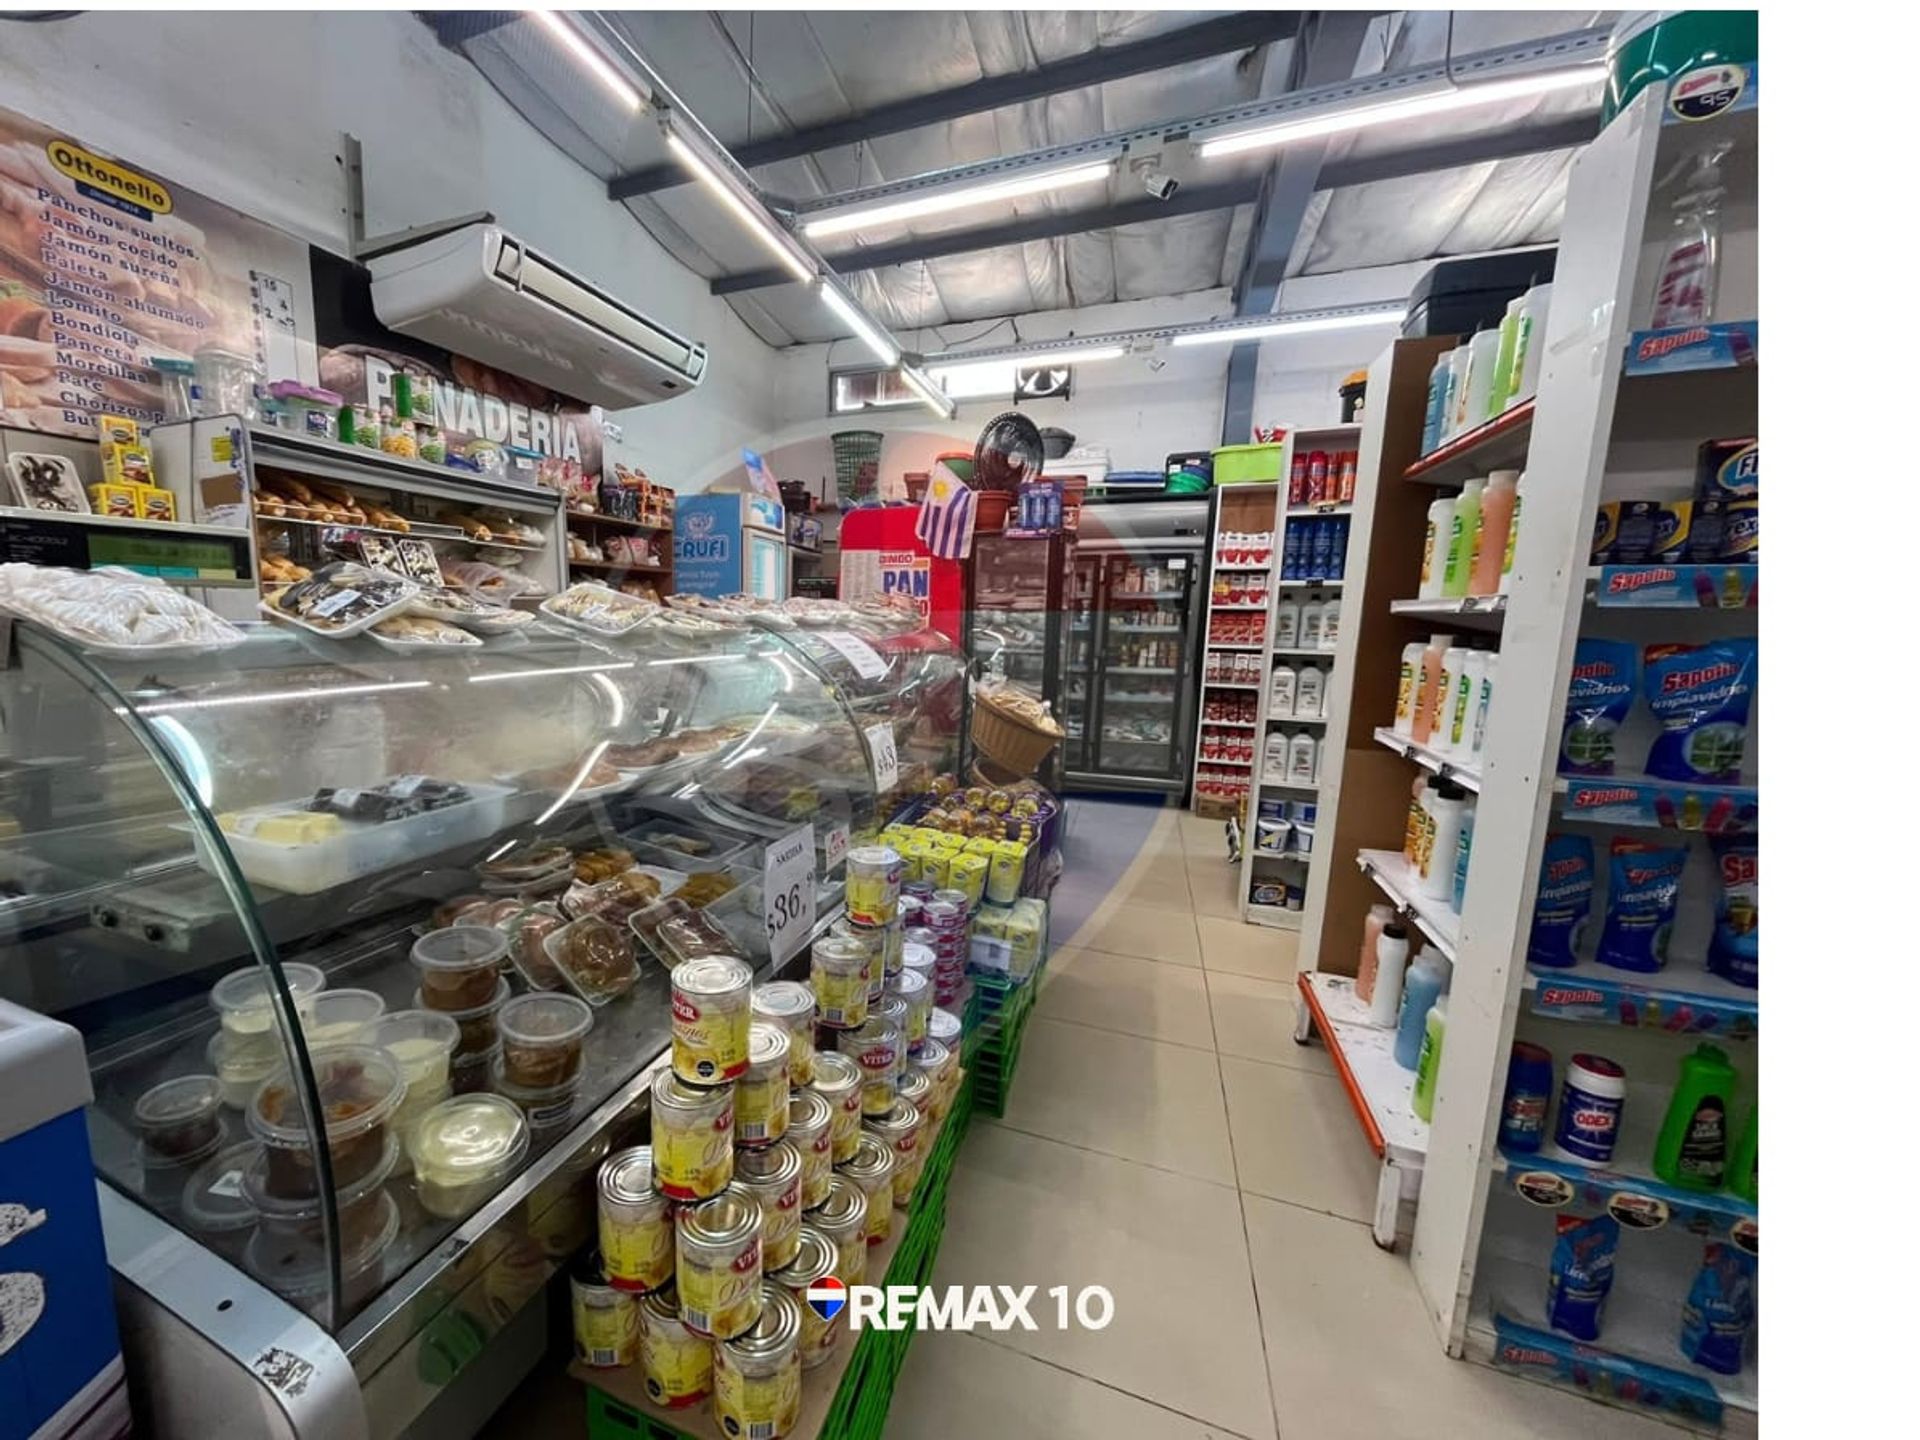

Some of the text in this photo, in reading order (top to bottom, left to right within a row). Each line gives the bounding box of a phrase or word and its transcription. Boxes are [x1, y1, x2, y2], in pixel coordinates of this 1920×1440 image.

[55, 149, 165, 206] Ottonello
[38, 187, 125, 231] Panchos
[39, 211, 178, 270] Jamón cocido
[41, 232, 112, 265] Jamón
[45, 250, 109, 281] Paleta
[49, 291, 123, 324] Lomito
[124, 298, 206, 330] ahumado
[52, 311, 140, 347] Bondiola
[54, 332, 134, 364] Panceta
[56, 352, 149, 384] Morcillas
[60, 391, 149, 419] Chorizos
[883, 570, 928, 597] PAN
[1576, 1110, 1612, 1127] ODEX
